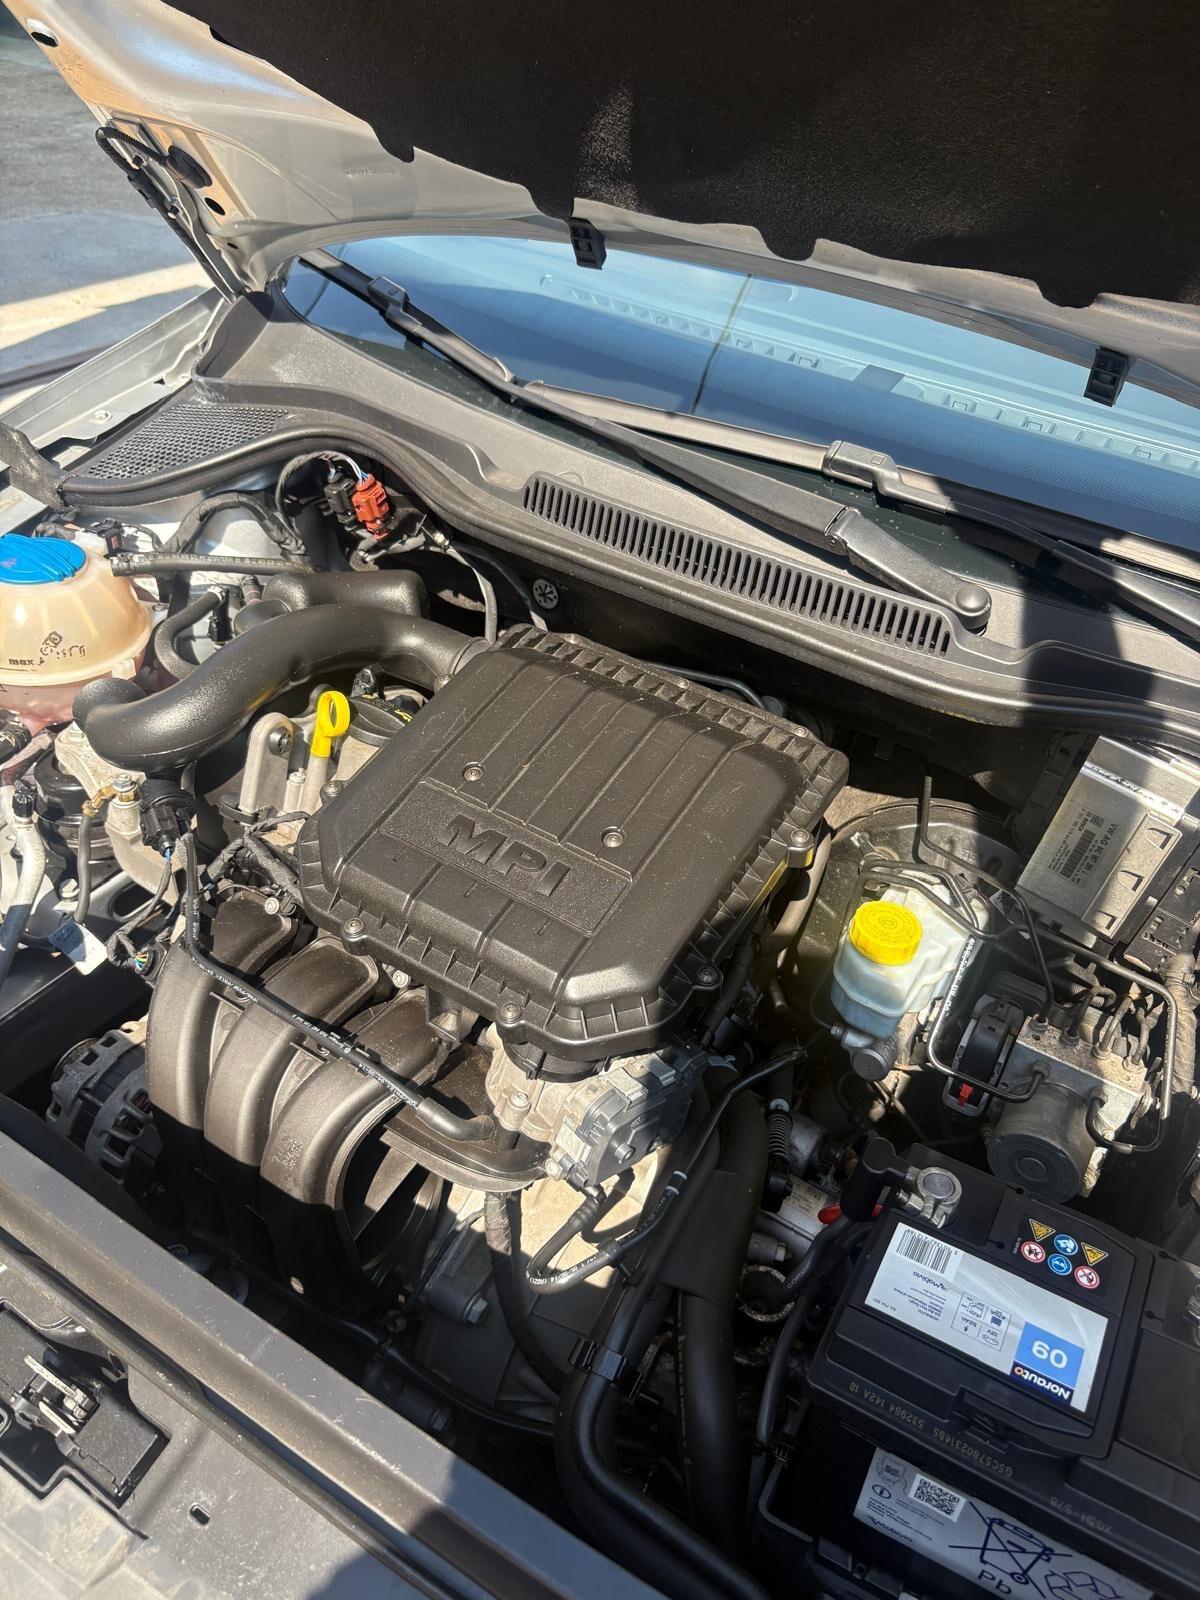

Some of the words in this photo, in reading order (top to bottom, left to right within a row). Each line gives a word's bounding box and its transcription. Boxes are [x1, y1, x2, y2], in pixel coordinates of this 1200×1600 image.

[1099, 834, 1110, 845] AG
[1106, 823, 1118, 835] VW
[435, 815, 570, 898] MPI
[911, 1270, 941, 1288] Mobivia
[986, 1328, 998, 1337] 12V
[1028, 1338, 1070, 1370] 09
[1013, 1364, 1071, 1399] Norauto
[978, 1570, 1012, 1595] Pb
